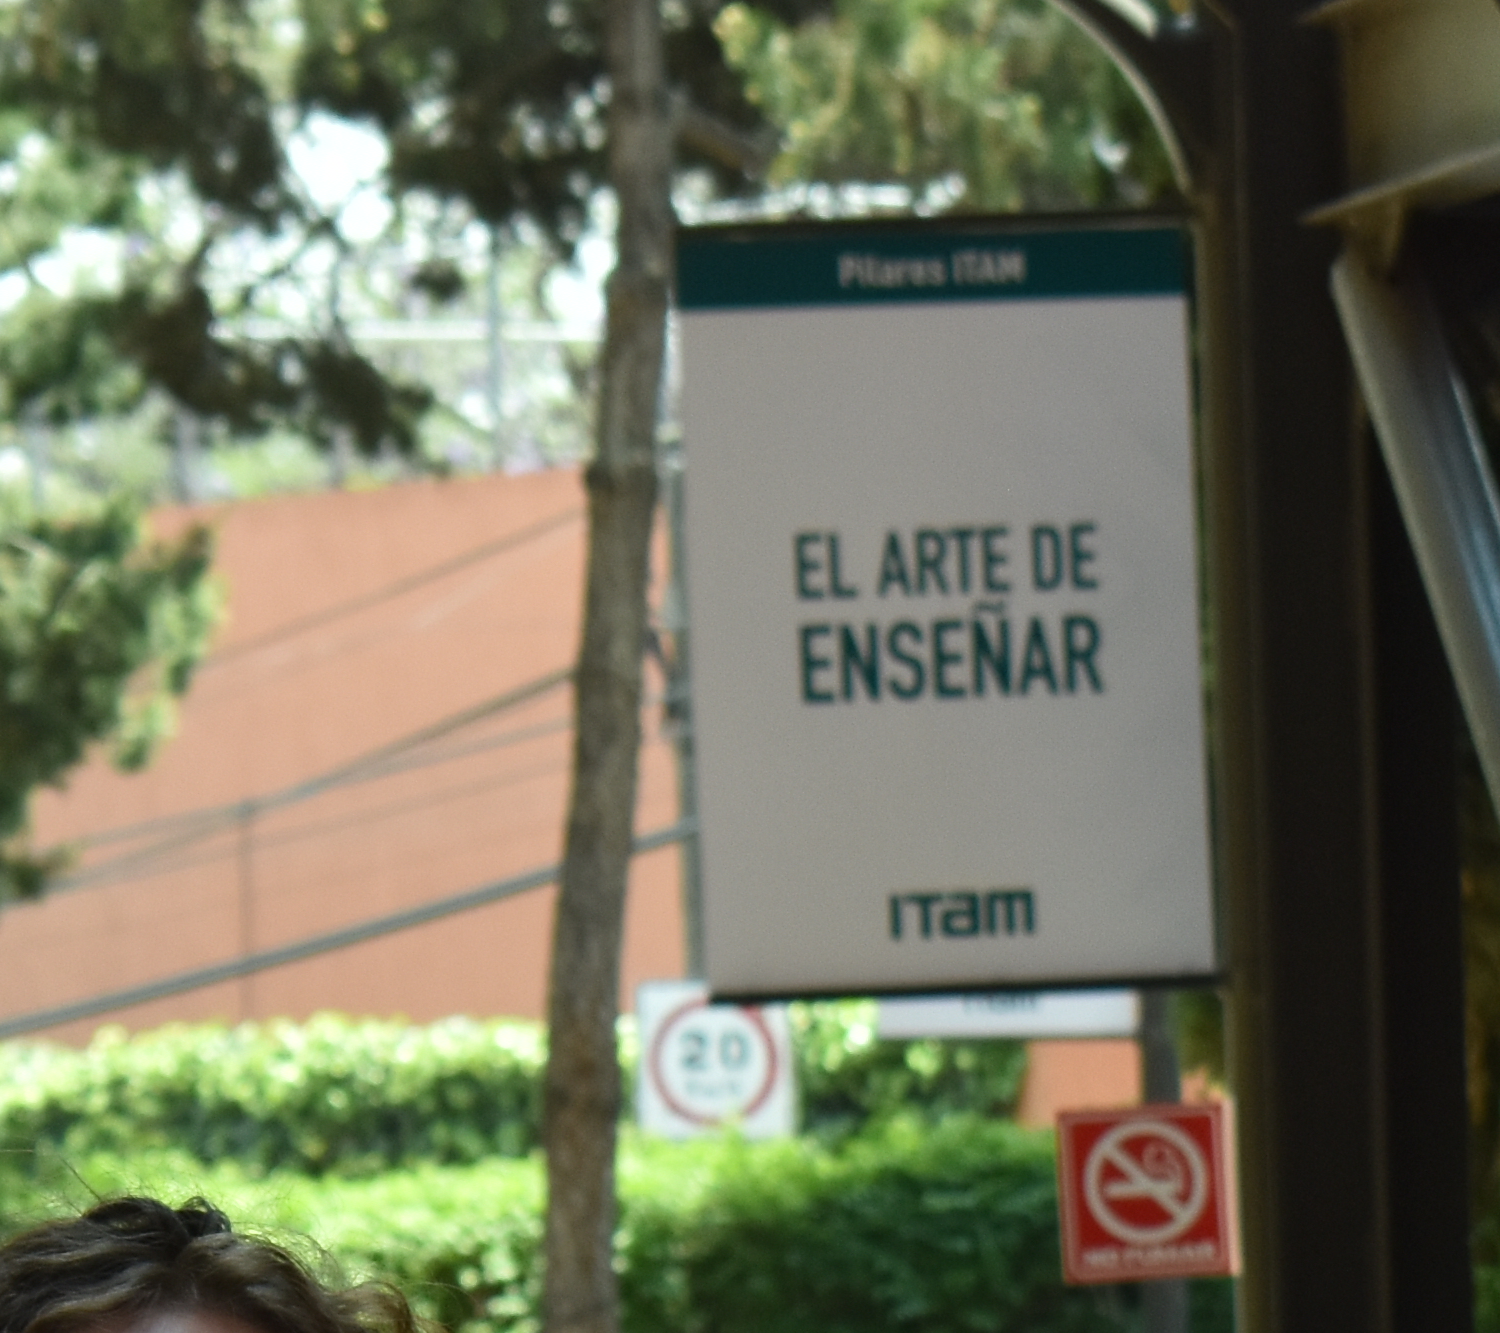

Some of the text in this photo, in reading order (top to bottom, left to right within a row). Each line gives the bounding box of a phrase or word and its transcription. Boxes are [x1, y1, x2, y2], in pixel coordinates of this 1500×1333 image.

[838, 250, 1027, 289] Pilares ITAM
[795, 521, 1099, 599] EL ARTE DE
[800, 601, 1104, 704] ENSEÑAR
[681, 1028, 750, 1071] 20
